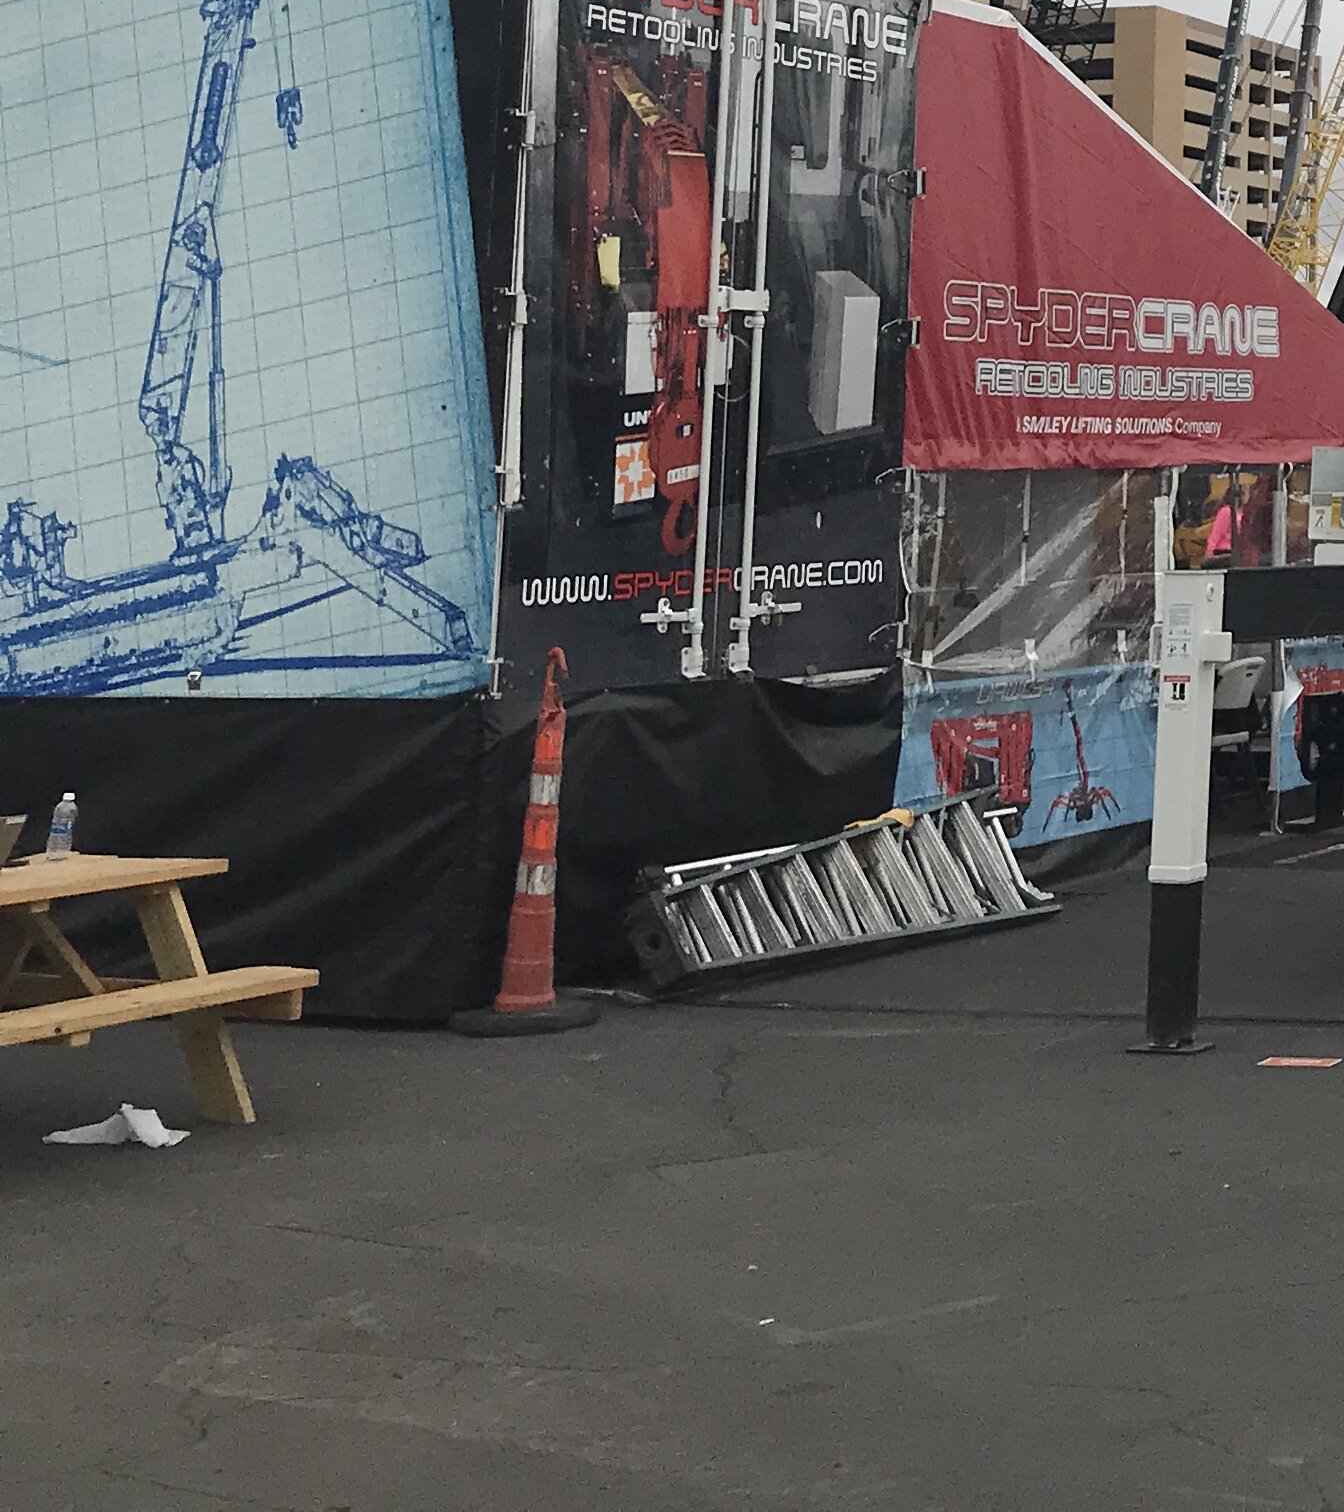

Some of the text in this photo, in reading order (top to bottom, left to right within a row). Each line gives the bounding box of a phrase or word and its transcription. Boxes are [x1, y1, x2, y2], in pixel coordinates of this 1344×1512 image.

[944, 280, 1280, 358] SPYDERCRANE
[976, 358, 1255, 402] RETOOLING INDUSTRIES
[1022, 416, 1071, 434] SMILEY
[1071, 416, 1112, 434] LIFTING
[1115, 417, 1173, 435] SOLUTIONS
[1175, 417, 1222, 438] Company
